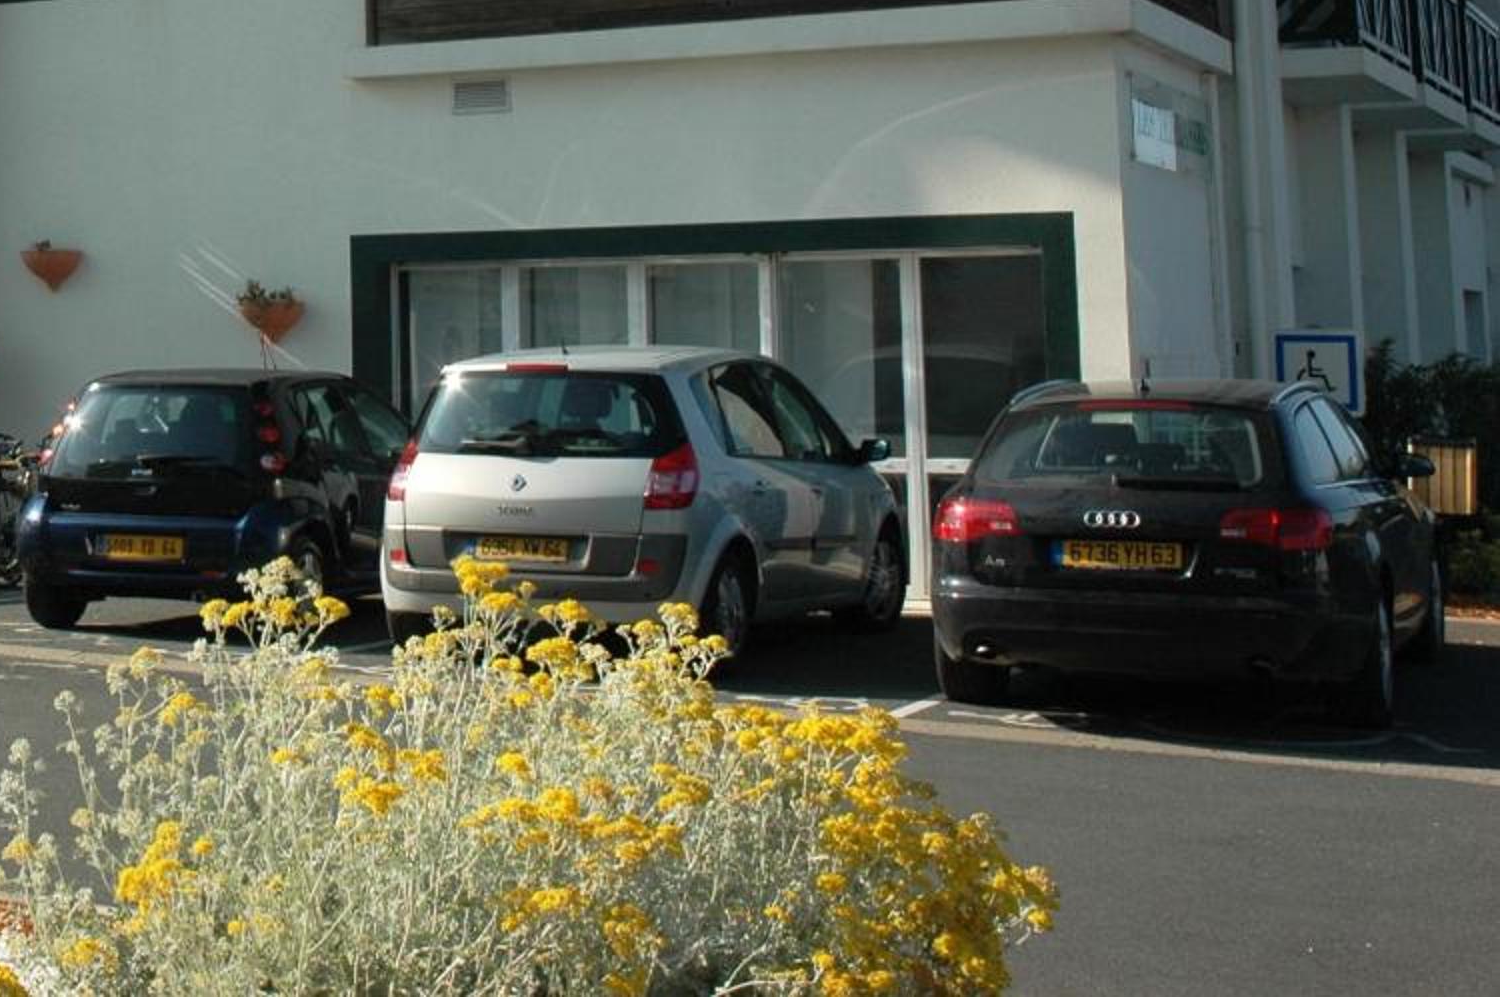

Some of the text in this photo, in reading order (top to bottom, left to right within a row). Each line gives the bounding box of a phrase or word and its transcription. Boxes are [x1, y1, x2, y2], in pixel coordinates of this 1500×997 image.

[1069, 542, 1177, 565] 6736 YH 63
